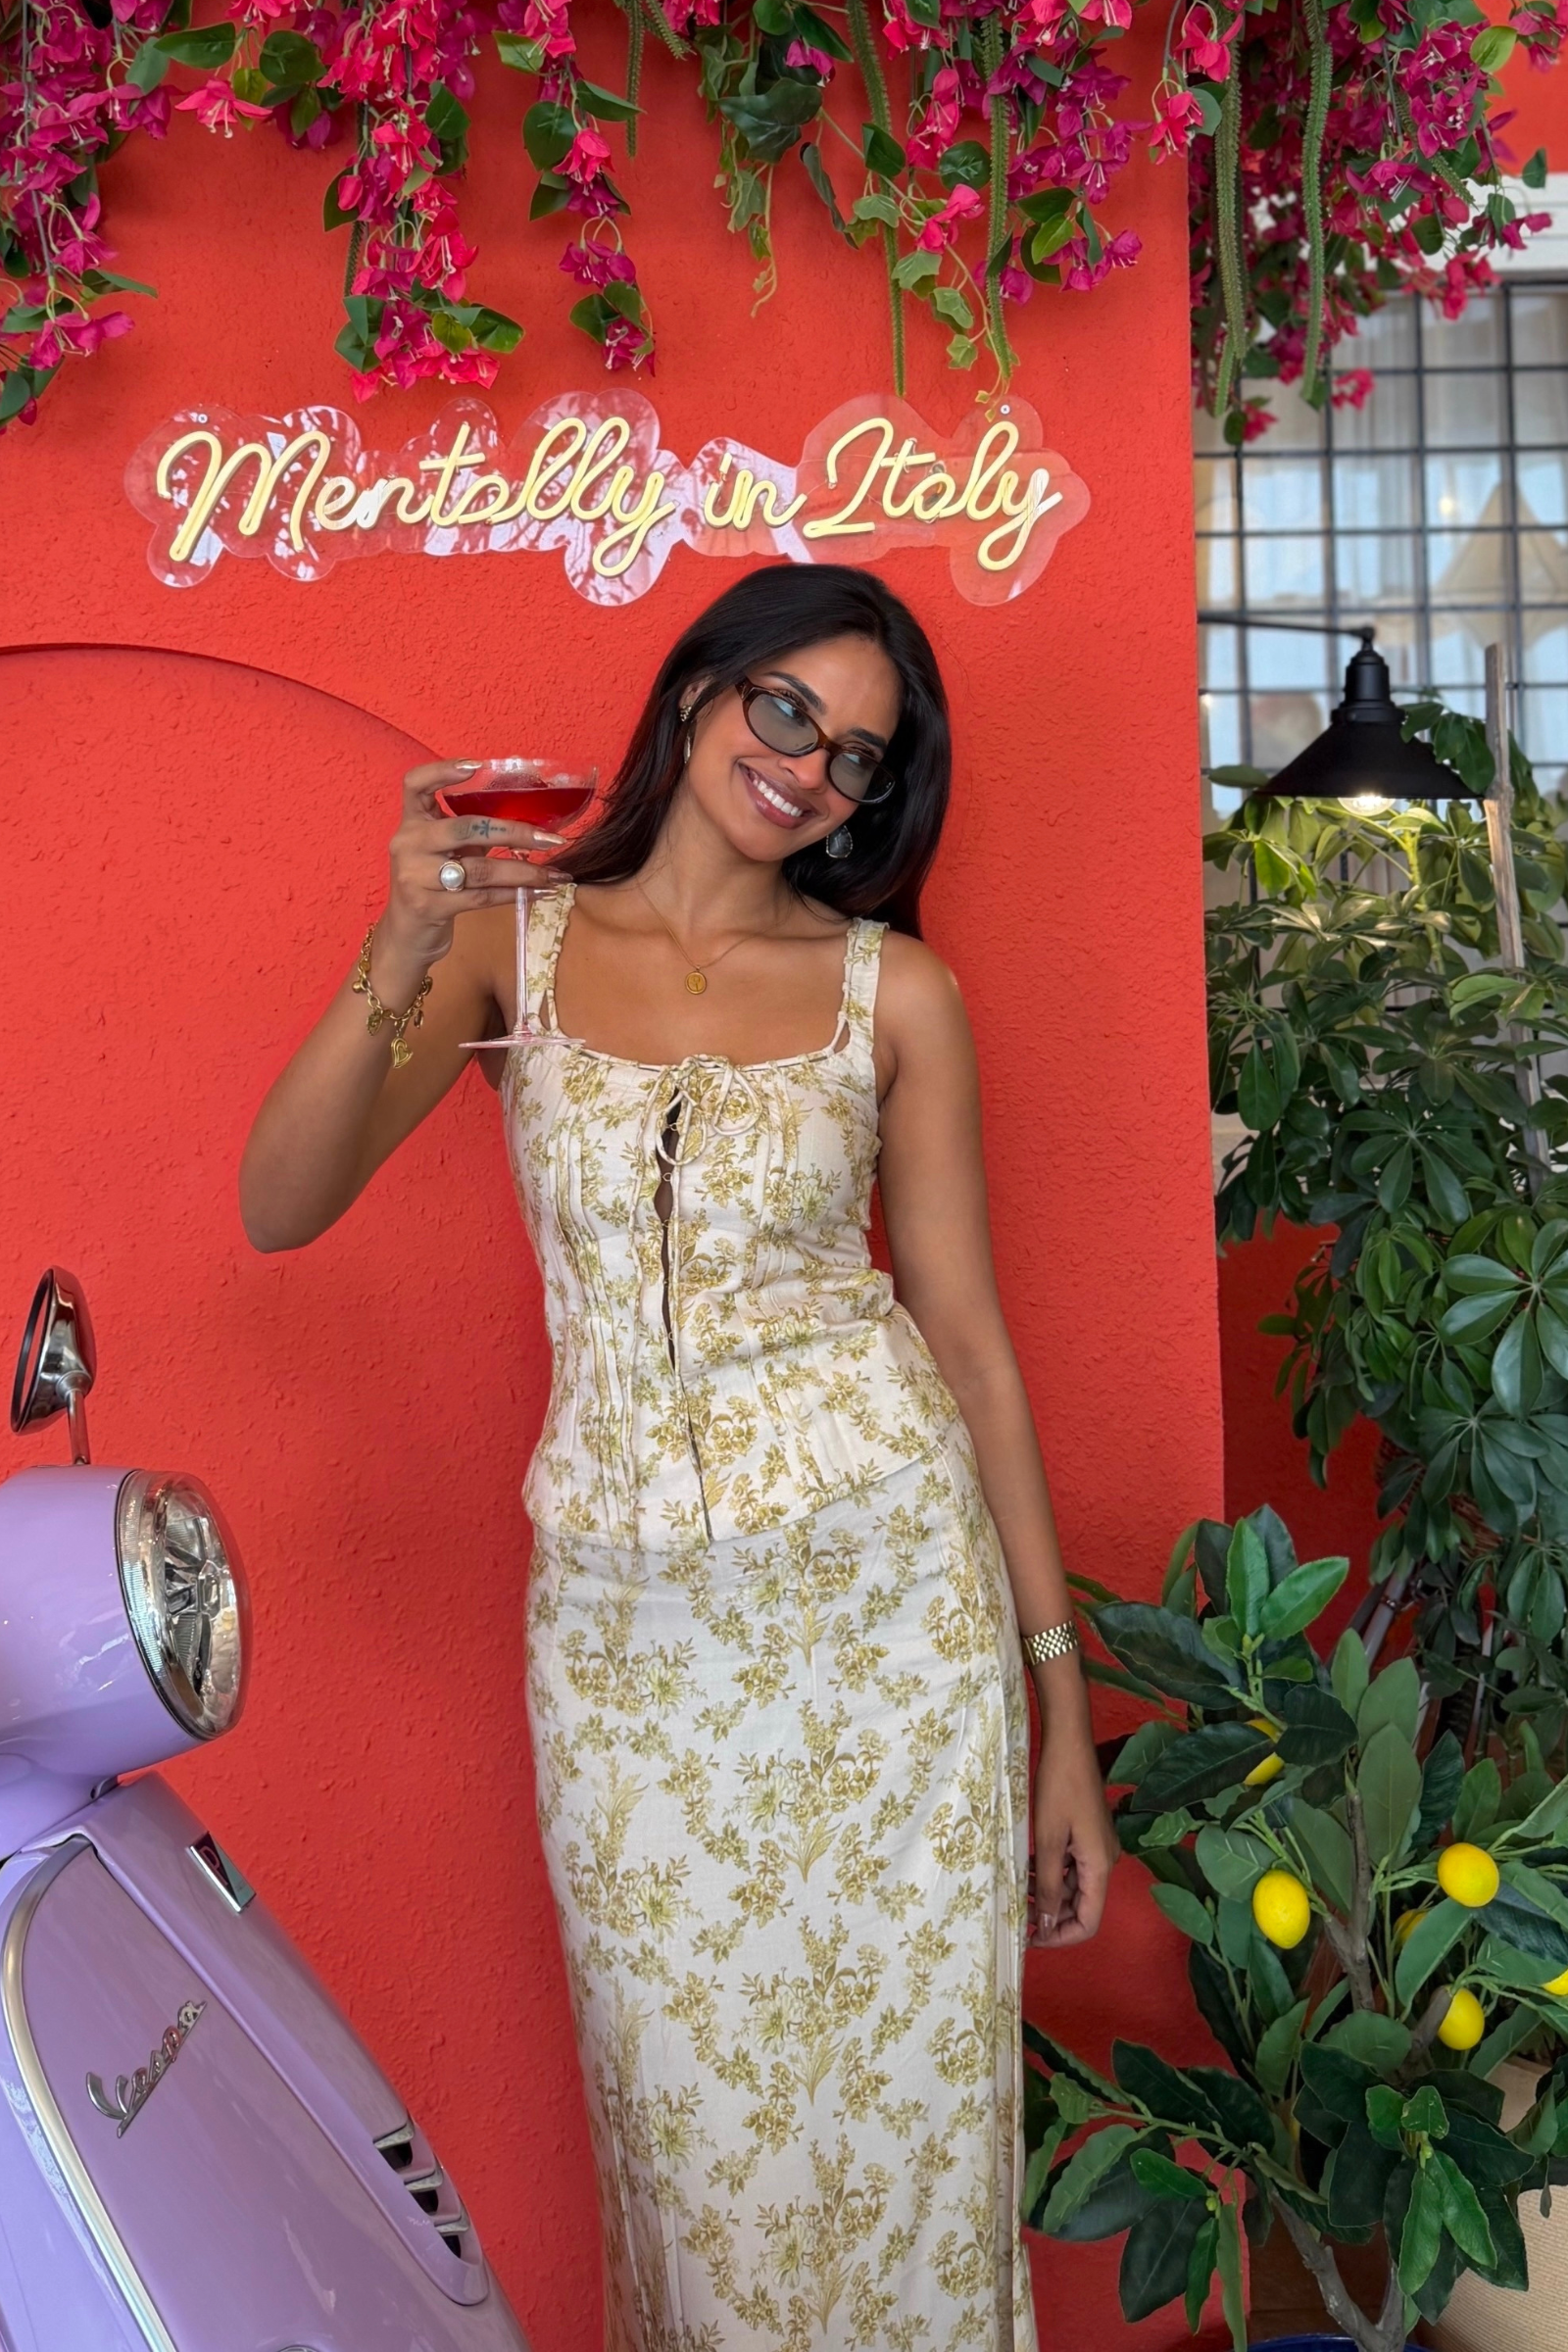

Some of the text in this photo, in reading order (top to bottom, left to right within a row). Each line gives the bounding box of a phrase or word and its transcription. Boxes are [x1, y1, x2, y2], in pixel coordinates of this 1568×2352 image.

[156, 416, 1063, 578] Mentally in Italy
[85, 2000, 208, 2138] Vespa
